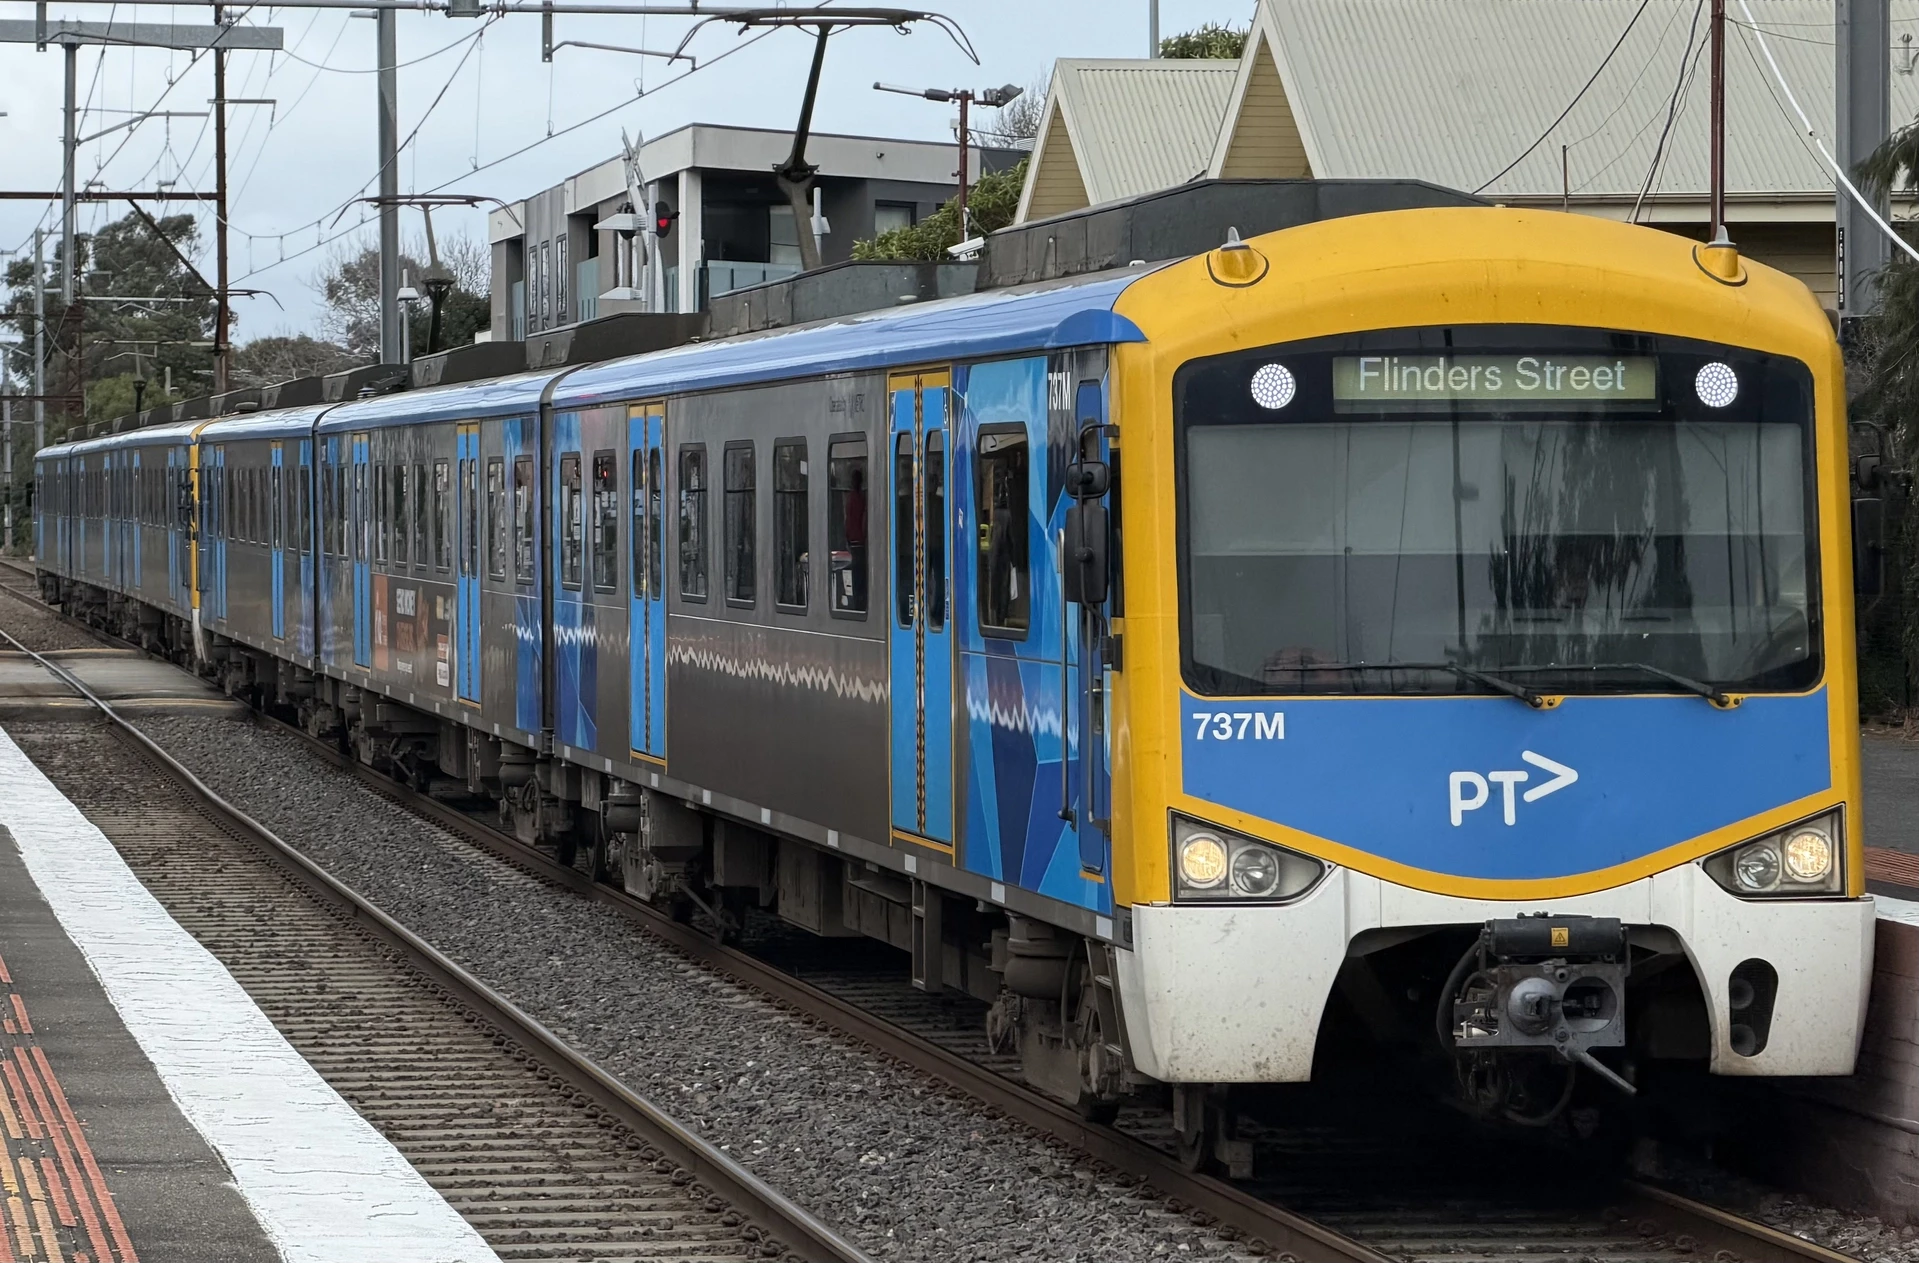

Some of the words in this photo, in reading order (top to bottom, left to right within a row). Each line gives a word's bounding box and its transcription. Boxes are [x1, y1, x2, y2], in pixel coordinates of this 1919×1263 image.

[1048, 371, 1071, 411] 737M
[1358, 357, 1502, 392] Flinders
[1515, 357, 1626, 392] Street
[1192, 711, 1285, 741] 737M
